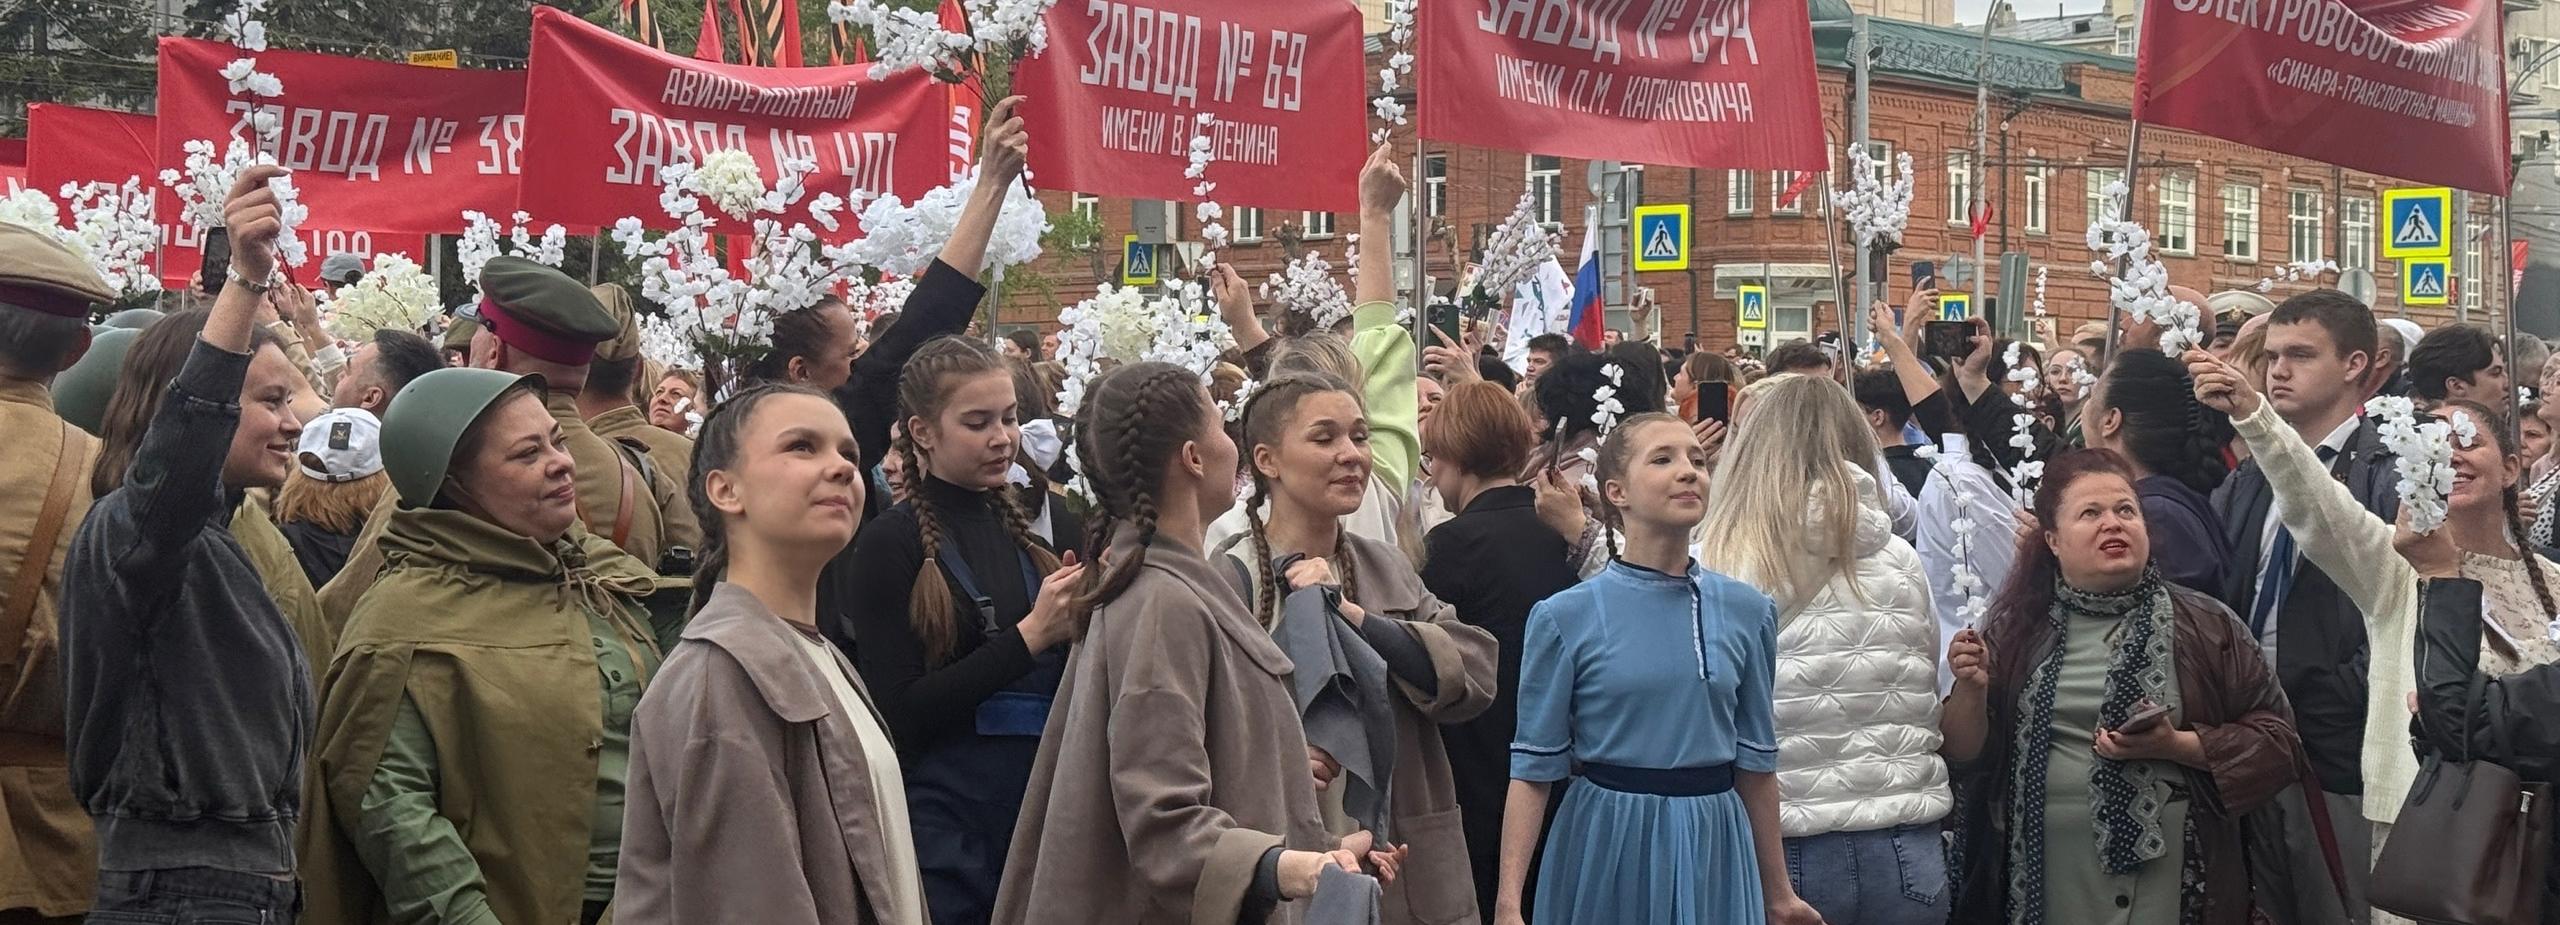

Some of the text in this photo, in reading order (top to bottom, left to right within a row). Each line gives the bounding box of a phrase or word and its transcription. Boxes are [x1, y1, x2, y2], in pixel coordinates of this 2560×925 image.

[1080, 0, 1308, 111] ЗАВОД № 69
[1635, 0, 1687, 58] №
[1688, 0, 1759, 65] 644
[2172, 0, 2477, 87] ЕКТРОВОЗОРЕМОНТНЫЙ
[661, 68, 859, 120] АВИАРЕМОНТНЫЙ
[1495, 53, 1566, 108] ИМЕНИ
[1619, 76, 1754, 123] КАГАНОВИЧА
[404, 116, 459, 174] №
[769, 128, 820, 184] №
[1102, 105, 1165, 154] ИМЕНИ
